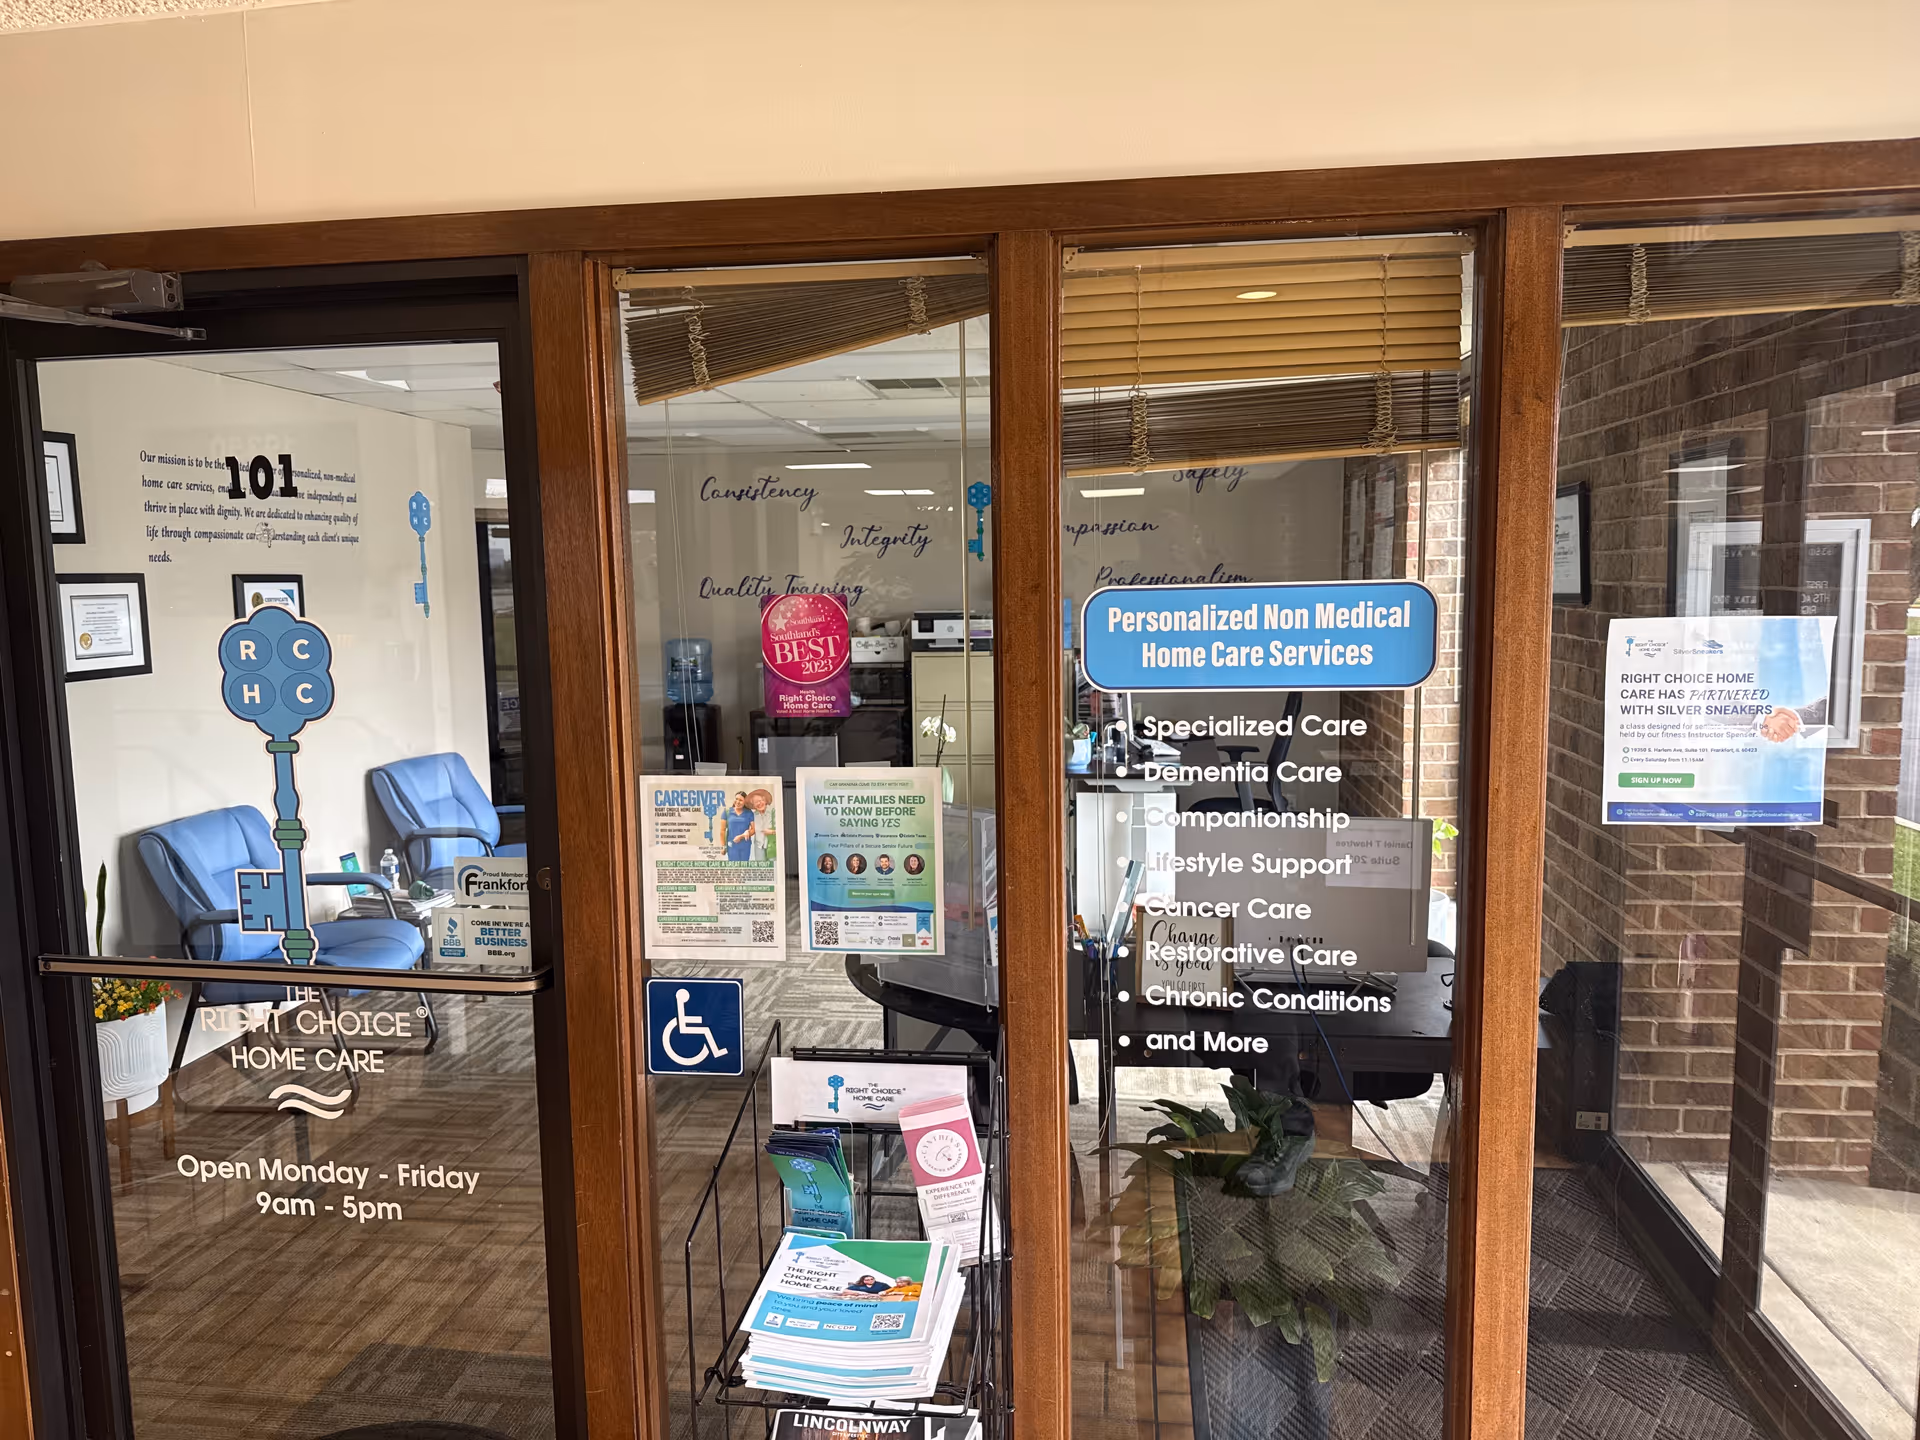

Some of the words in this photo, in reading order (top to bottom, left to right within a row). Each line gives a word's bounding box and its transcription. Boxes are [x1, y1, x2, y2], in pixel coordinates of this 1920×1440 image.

[140, 450, 155, 463] Our
[158, 453, 186, 466] mission
[188, 456, 194, 467] is
[196, 457, 203, 468] to
[204, 457, 212, 469] be
[215, 458, 225, 470] the
[225, 454, 298, 500] 101
[142, 475, 163, 488] home
[166, 480, 182, 490] care
[186, 481, 214, 494] services,
[307, 490, 344, 505] independently
[346, 493, 356, 503] and
[700, 475, 820, 512] Consistency
[144, 500, 167, 514] thrive
[169, 502, 177, 514] in
[179, 502, 198, 518] place
[200, 504, 215, 516] with
[217, 505, 242, 520] dignity.
[244, 506, 254, 518] We
[256, 510, 266, 518] are
[267, 508, 296, 520] dedicated
[297, 512, 303, 520] to
[304, 510, 332, 526] enhancing
[333, 512, 351, 526] quality
[146, 525, 158, 542] life
[162, 526, 192, 542] through
[194, 529, 244, 542] compassionate
[308, 532, 320, 542] each
[341, 534, 359, 546] unique
[840, 523, 932, 558] Integrity
[149, 550, 172, 562] needs.
[698, 575, 776, 608] Quality
[784, 574, 868, 607] Training
[1108, 603, 1258, 633] Personalized
[1263, 604, 1307, 631] Non
[1314, 600, 1411, 630] Medical
[770, 628, 820, 642] Southland's
[240, 640, 257, 660] R
[292, 639, 310, 660] C
[772, 635, 840, 664] BEST
[1142, 640, 1206, 668] Home
[1210, 640, 1265, 667] Care
[1269, 639, 1373, 667] Services
[801, 659, 833, 674] 2023
[1621, 674, 1661, 683] RIGHT
[1664, 673, 1713, 684] CHOICE
[1716, 673, 1754, 683] HOME
[242, 684, 260, 704] H
[296, 683, 314, 703] C
[779, 694, 802, 703] Right
[1620, 689, 1655, 699] CARE
[1658, 689, 1685, 699] HAS
[1690, 688, 1769, 701] PARTNERED
[812, 701, 832, 709] Care
[1620, 705, 1654, 715] WITH
[1657, 705, 1702, 715] SILVER
[1705, 705, 1773, 715] SNEAKERS
[1143, 715, 1293, 740] Specialized
[1300, 715, 1367, 737] Care
[1636, 731, 1645, 739] by
[1648, 723, 1680, 731] designed
[1144, 762, 1269, 783] Dementia
[1276, 762, 1342, 783] Care
[654, 790, 726, 807] CAREGIVER
[813, 796, 845, 804] WHAT
[847, 796, 895, 804] FAMILIES
[898, 796, 926, 804] NEED
[824, 807, 838, 815] TO
[841, 807, 872, 815] KNOW
[875, 807, 916, 815] BEFORE
[1144, 806, 1350, 833] Companionship
[840, 818, 878, 827] SAYING
[881, 818, 900, 827] YES
[1146, 852, 1243, 876] Lifestyle
[1251, 852, 1352, 879] Support
[1144, 896, 1240, 918] Cancer
[1247, 898, 1312, 920] Care
[443, 938, 461, 946] BBB
[475, 937, 528, 947] BUSINESS
[480, 928, 521, 937] BETTER
[1149, 920, 1219, 948] Change
[488, 950, 515, 958] BBB.org
[1145, 941, 1285, 965] Restorative
[1292, 944, 1358, 966] Care
[286, 986, 320, 1003] THE
[1145, 984, 1244, 1008] Chronic
[1252, 988, 1392, 1012] Conditions
[200, 1008, 280, 1034] RIGHT
[1146, 1030, 1195, 1052] and
[1204, 1031, 1269, 1054] More
[231, 1045, 306, 1071] HOME
[315, 1048, 385, 1073] CARE
[177, 1154, 250, 1183] Open
[259, 1157, 369, 1189] Monday
[398, 1163, 480, 1195] Friday
[925, 1183, 962, 1194] EXPERIENCE
[964, 1179, 976, 1187] THE
[933, 1188, 971, 1200] DIFFERENCE
[256, 1191, 316, 1216] 9am
[342, 1195, 402, 1223] 5pm
[786, 1266, 805, 1274] THE
[807, 1270, 838, 1278] RIGHT
[780, 1278, 812, 1288] HOME
[814, 1284, 842, 1292] CARE
[793, 1414, 911, 1433] LINCOLNWAY
